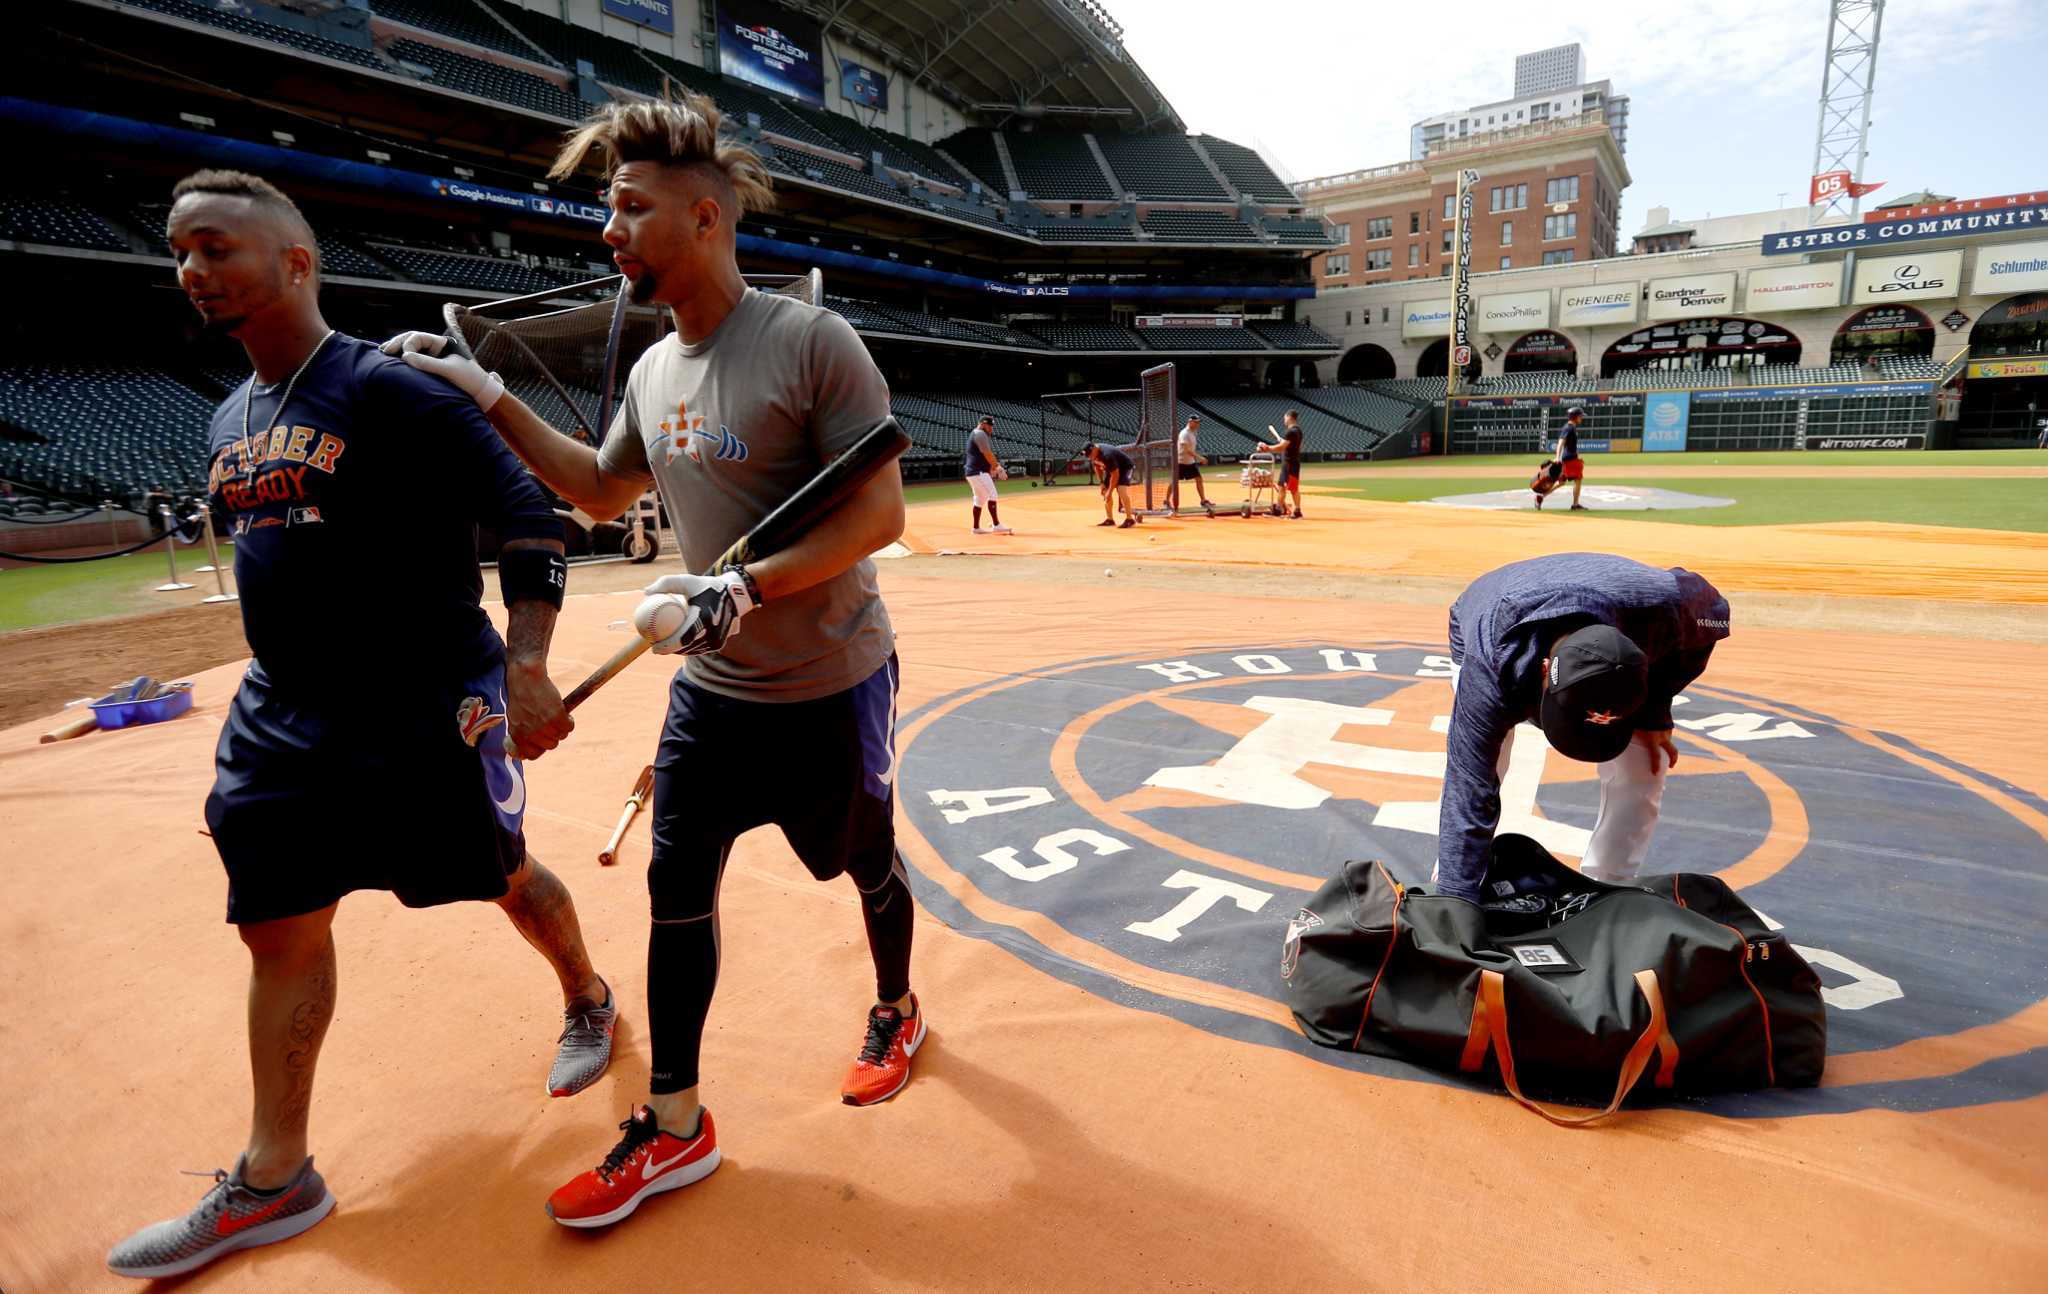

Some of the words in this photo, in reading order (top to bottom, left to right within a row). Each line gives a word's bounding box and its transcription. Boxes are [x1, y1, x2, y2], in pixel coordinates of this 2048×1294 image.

[735, 24, 809, 61] POSTSEASON
[1817, 176, 1841, 194] 05
[450, 184, 485, 201] Google
[485, 192, 525, 207] Assistant
[555, 203, 606, 222] ALCS
[1460, 197, 1472, 266] CHIKIN
[1775, 227, 1867, 250] ASTROS
[1878, 207, 2048, 238] COMMUNITY
[1036, 287, 1069, 296] ALCS
[1655, 287, 1706, 299] Gardner
[1753, 281, 1834, 294] HALLIBURTON
[1867, 279, 1944, 294] LEXUS
[1567, 292, 1632, 306] CHENIERE
[1681, 295, 1728, 307] Denver
[1456, 294, 1468, 344] FARE
[1486, 306, 1542, 320] ConocoPhillips
[2003, 363, 2036, 376] Fiesta
[1648, 429, 1681, 442] AT&T
[1820, 437, 1908, 449] NITTOTIRE.COM
[208, 425, 345, 495] OCTOBER
[222, 466, 308, 512] READY
[548, 568, 565, 589] 15
[1520, 949, 1553, 964] 85
